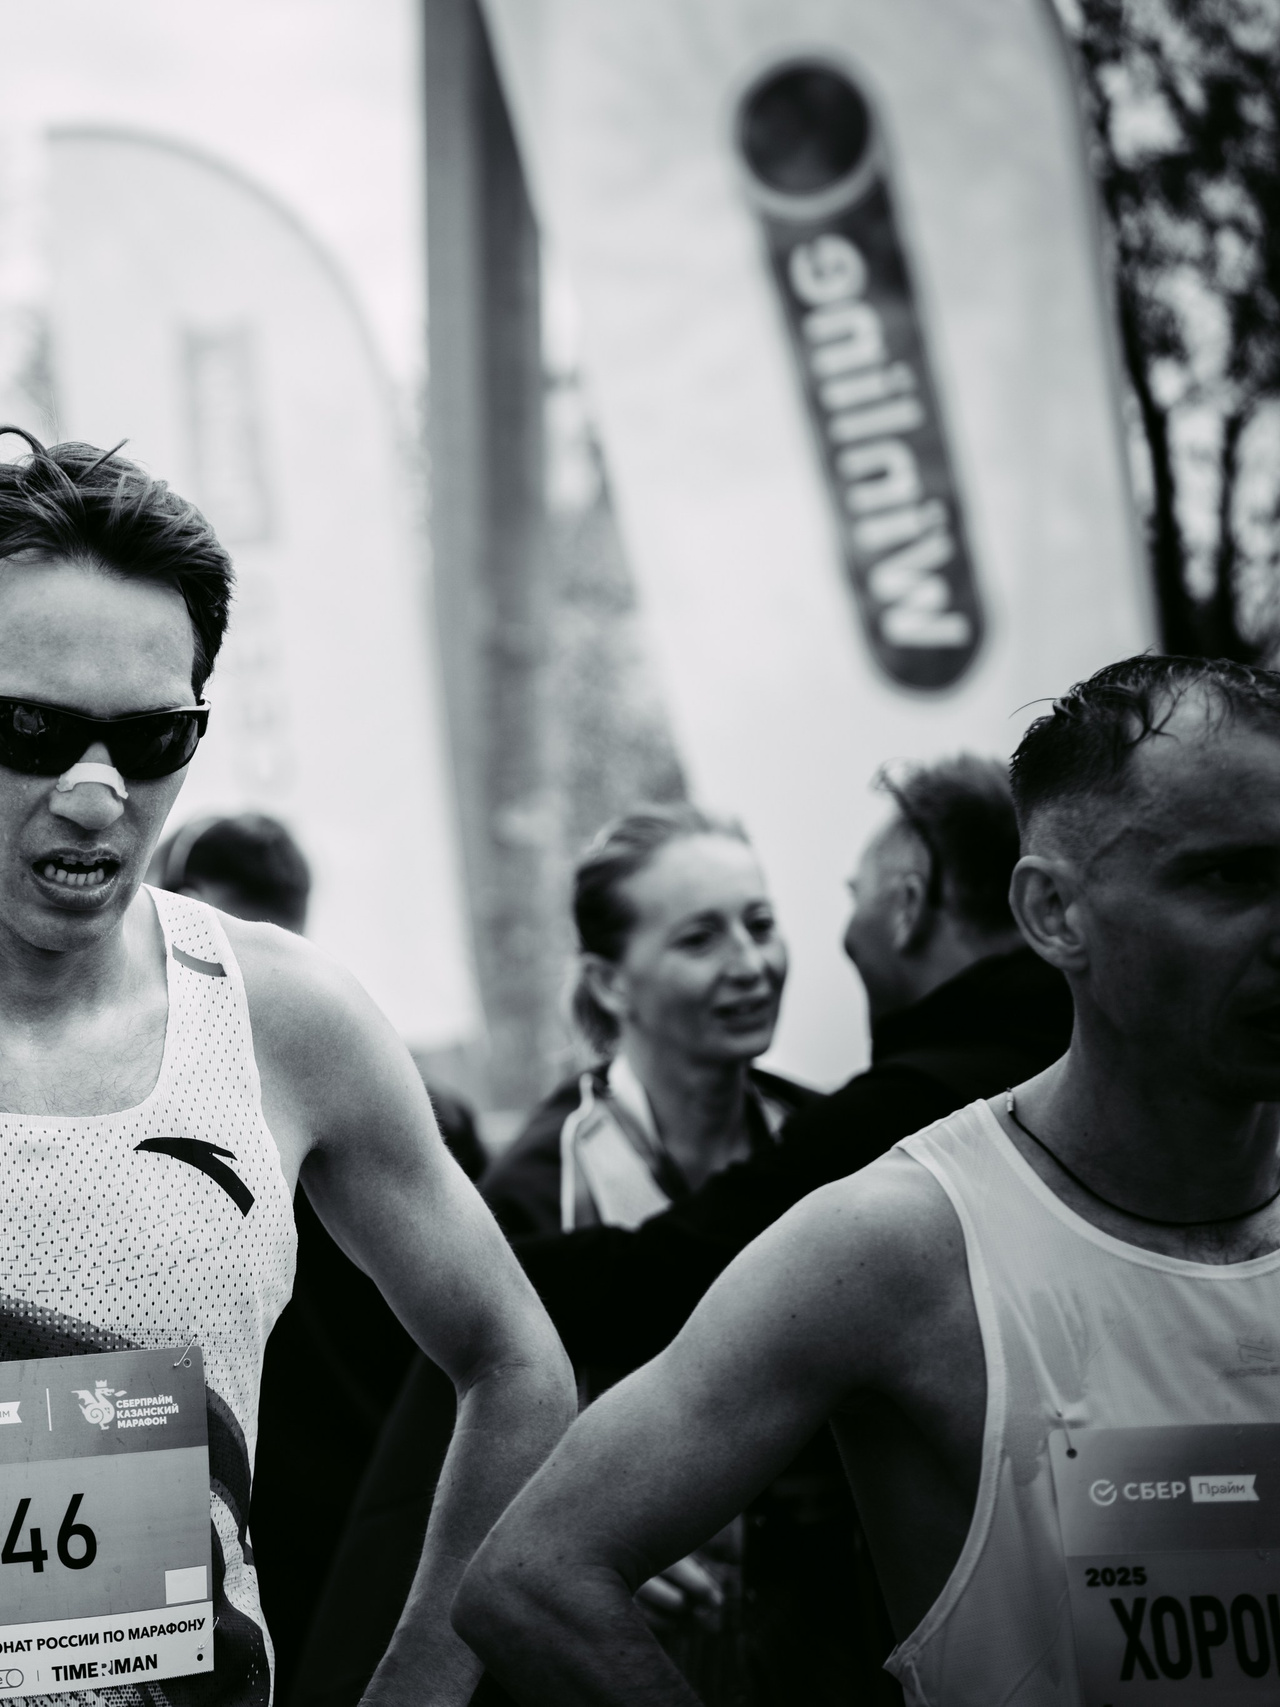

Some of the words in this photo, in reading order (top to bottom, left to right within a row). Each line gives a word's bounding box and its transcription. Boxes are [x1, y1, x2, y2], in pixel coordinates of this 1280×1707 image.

[115, 1394, 173, 1409] СБЕРПРАЙМ
[116, 1403, 180, 1419] КАЗАНСКИЙ
[117, 1416, 168, 1429] МАРАФОН
[1122, 1481, 1187, 1500] СБЕР
[1198, 1481, 1246, 1497] Прайм
[1, 1493, 98, 1573] 46
[1084, 1566, 1148, 1588] 2025
[37, 1632, 100, 1651] РОССИИ
[103, 1629, 125, 1645] ПО
[128, 1618, 206, 1641] МАРАФОНУ
